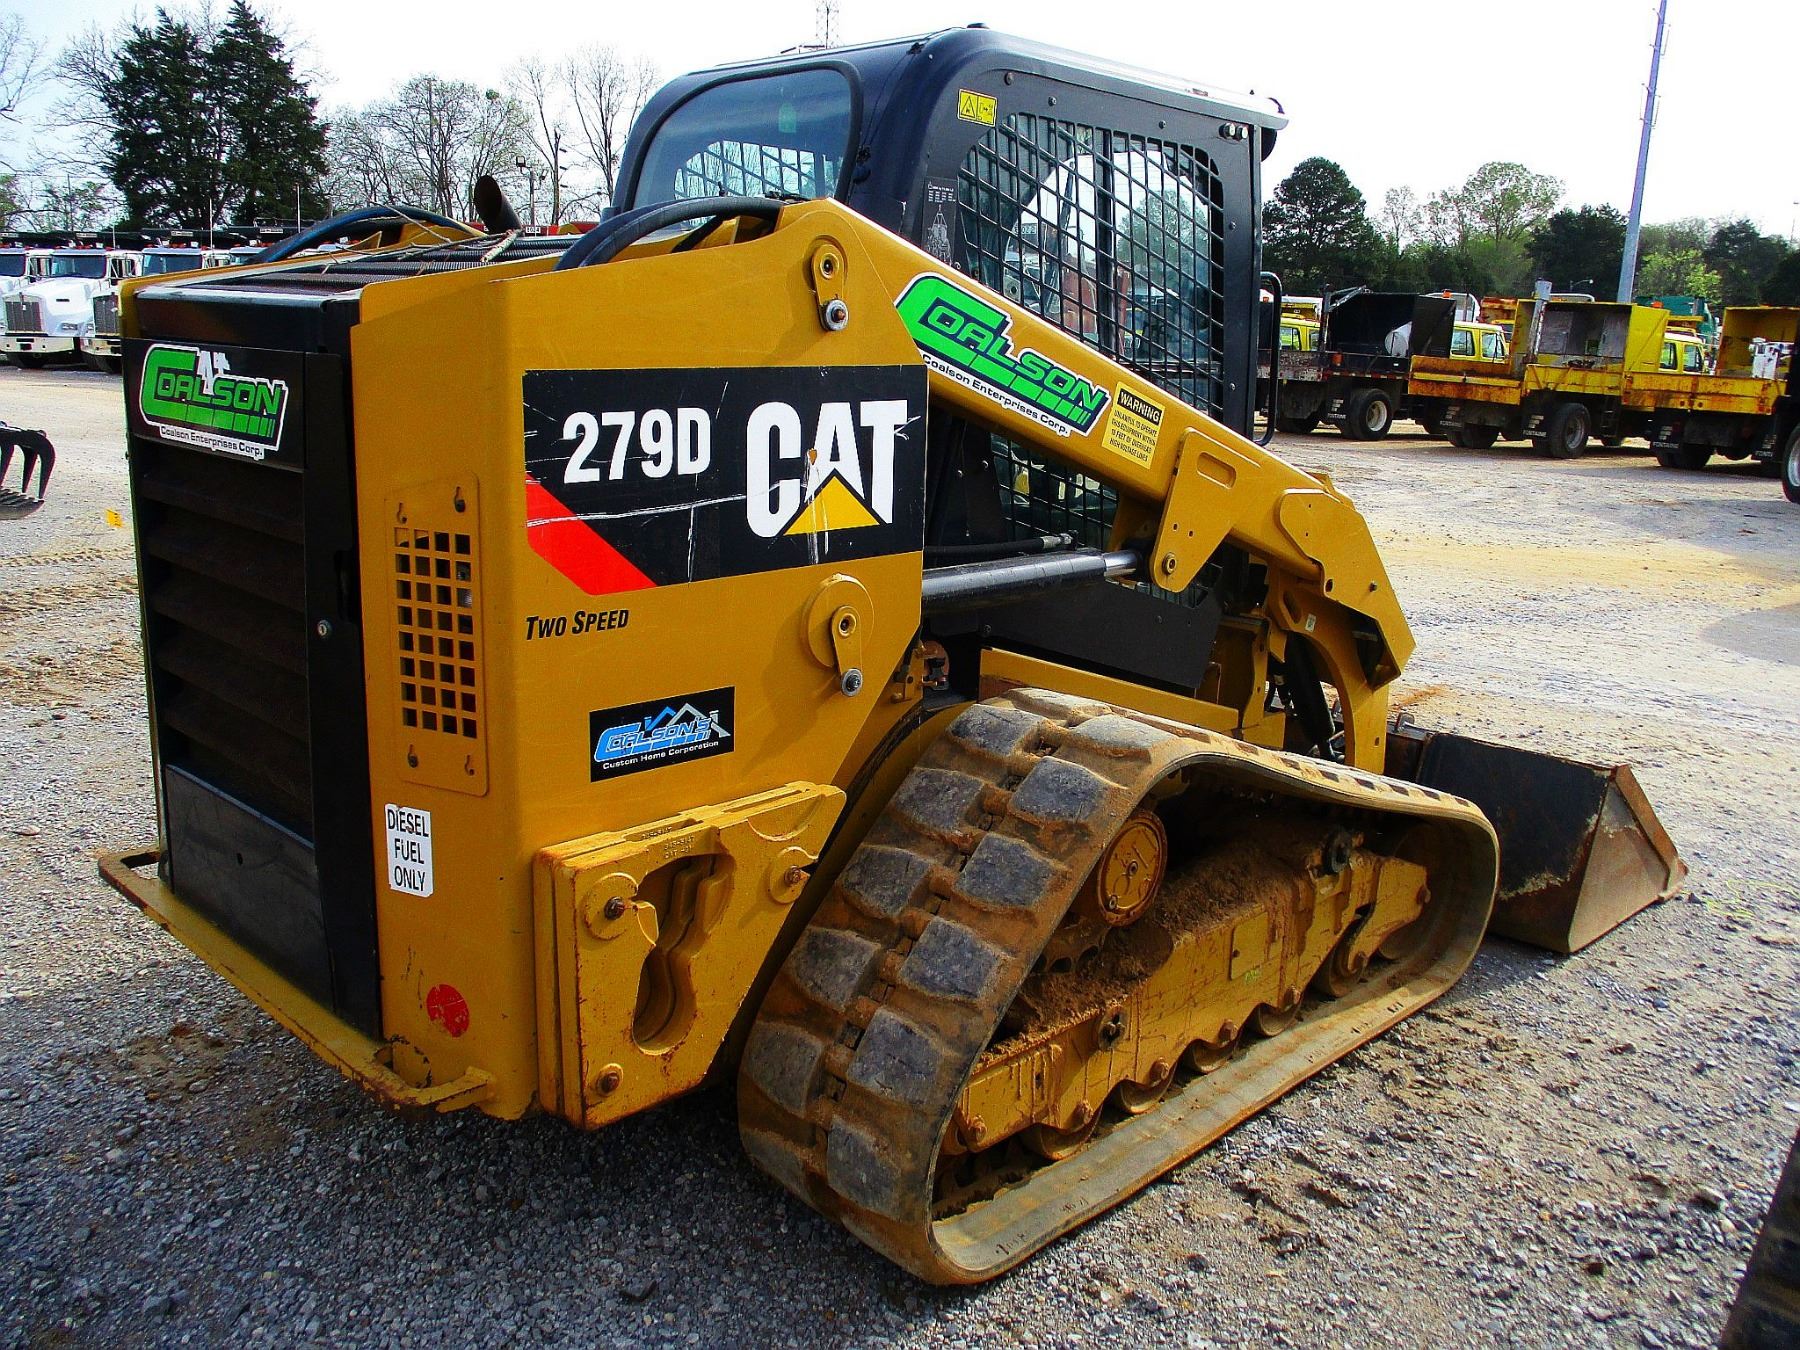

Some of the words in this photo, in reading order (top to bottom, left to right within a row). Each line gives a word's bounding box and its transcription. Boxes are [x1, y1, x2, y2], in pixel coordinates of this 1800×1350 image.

[897, 277, 1108, 424] COALSON
[141, 349, 283, 437] COALSON
[922, 353, 970, 385] Coalson
[972, 376, 1039, 420] Enterprises
[1040, 414, 1068, 435] Corp.
[1120, 391, 1160, 423] WARNING
[161, 425, 190, 441] Coalson
[190, 432, 238, 451] Enterprises
[238, 441, 263, 457] Corp.
[563, 407, 711, 484] 279D
[746, 399, 908, 538] CAT
[602, 757, 639, 770] Custom
[640, 751, 666, 763] Home
[668, 740, 719, 756] Corporation
[387, 808, 429, 838] DIESEL
[394, 838, 425, 865] FUEL
[394, 865, 426, 892] ONLY
